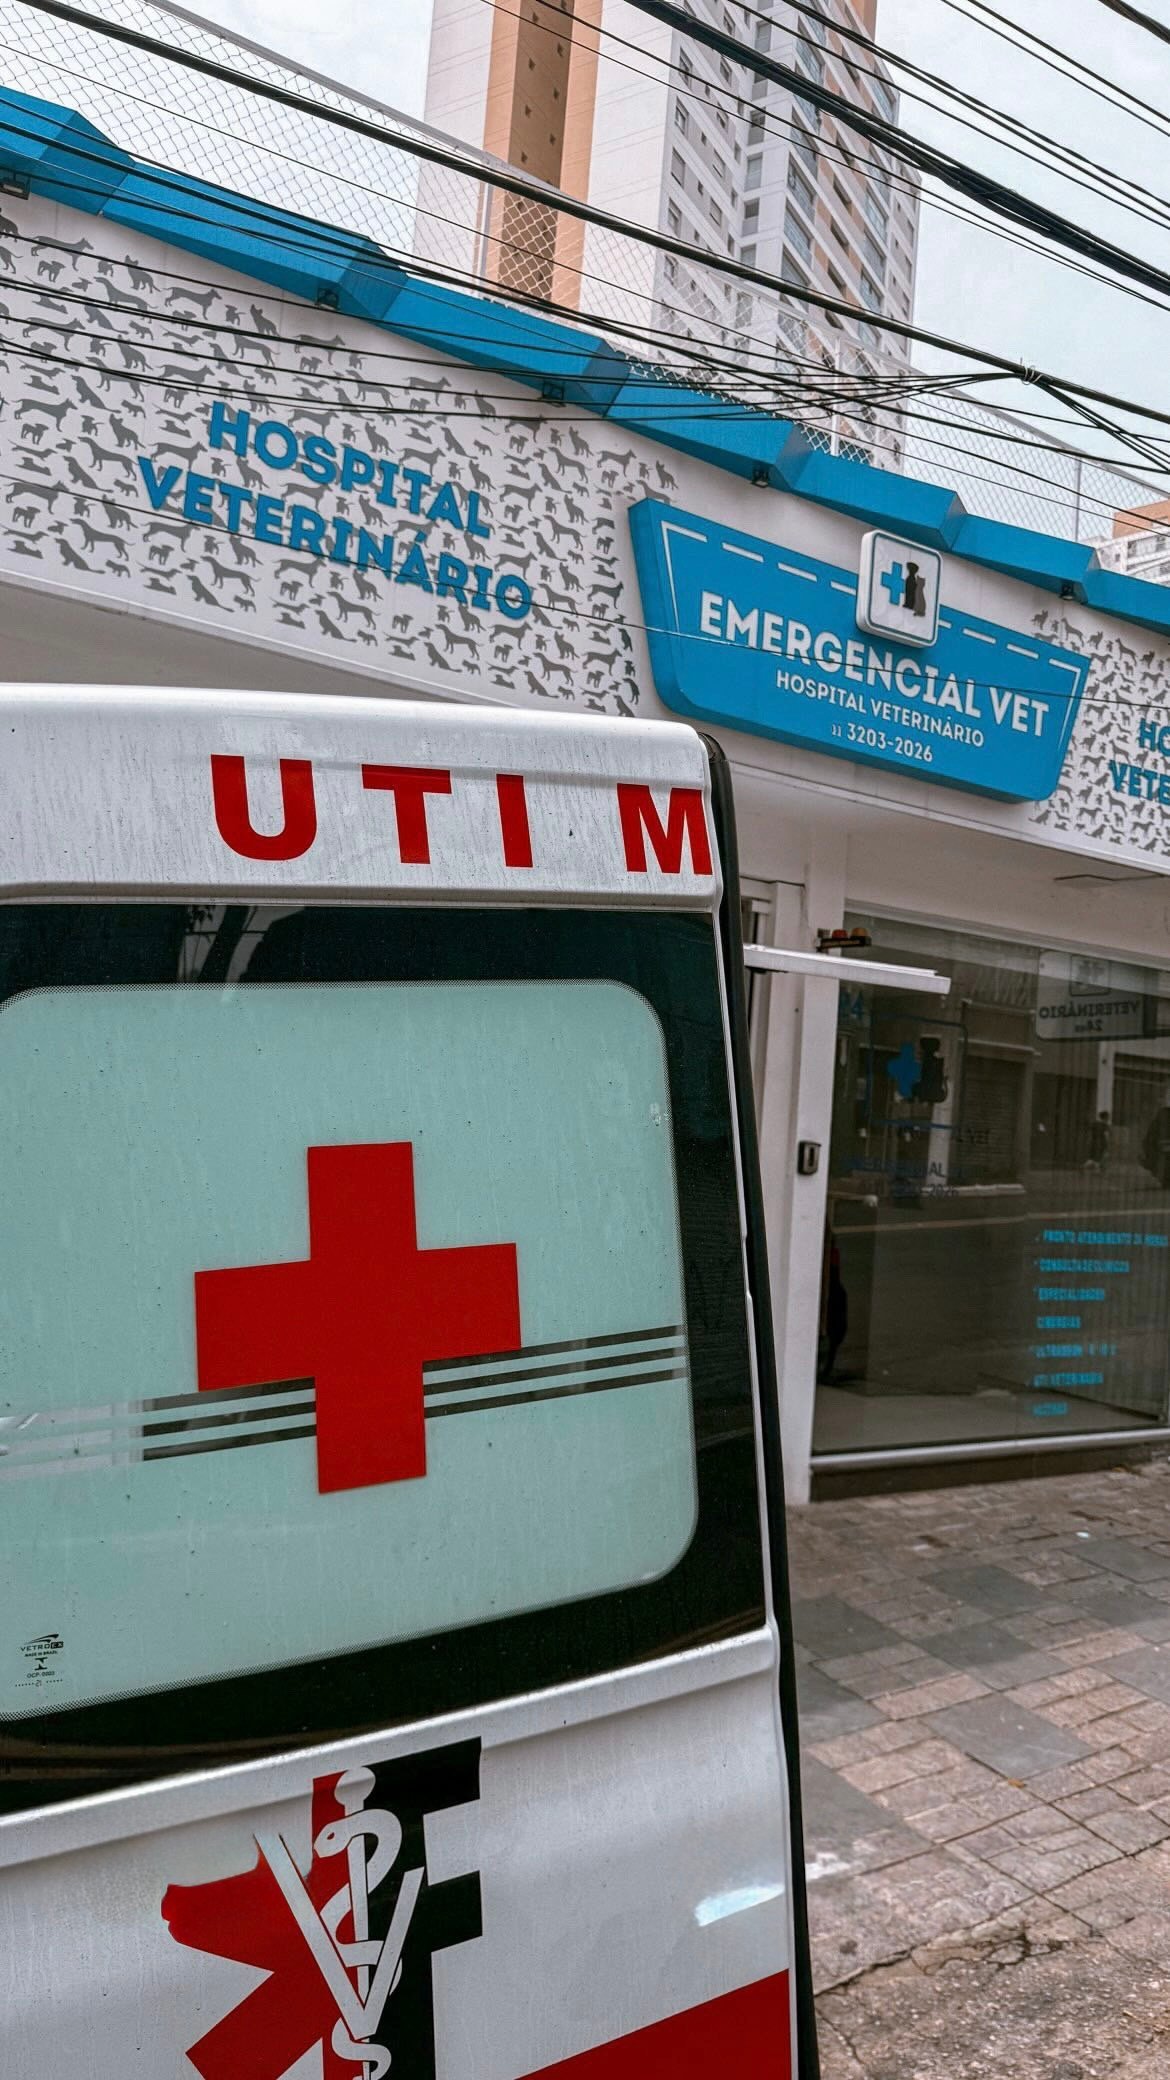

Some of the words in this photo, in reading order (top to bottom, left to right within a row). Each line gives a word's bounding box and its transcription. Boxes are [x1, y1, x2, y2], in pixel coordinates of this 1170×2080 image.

[208, 401, 491, 537] HOSPITAL
[137, 456, 535, 621] VETERINÁRIO
[700, 591, 980, 718] EMERGENCIAL
[988, 685, 1050, 737] VET
[776, 669, 867, 715] HOSPITAL
[870, 698, 985, 748] VETERINÁRIO
[846, 724, 933, 763] 3203-2026
[210, 754, 533, 868] UTI
[616, 783, 713, 875] M
